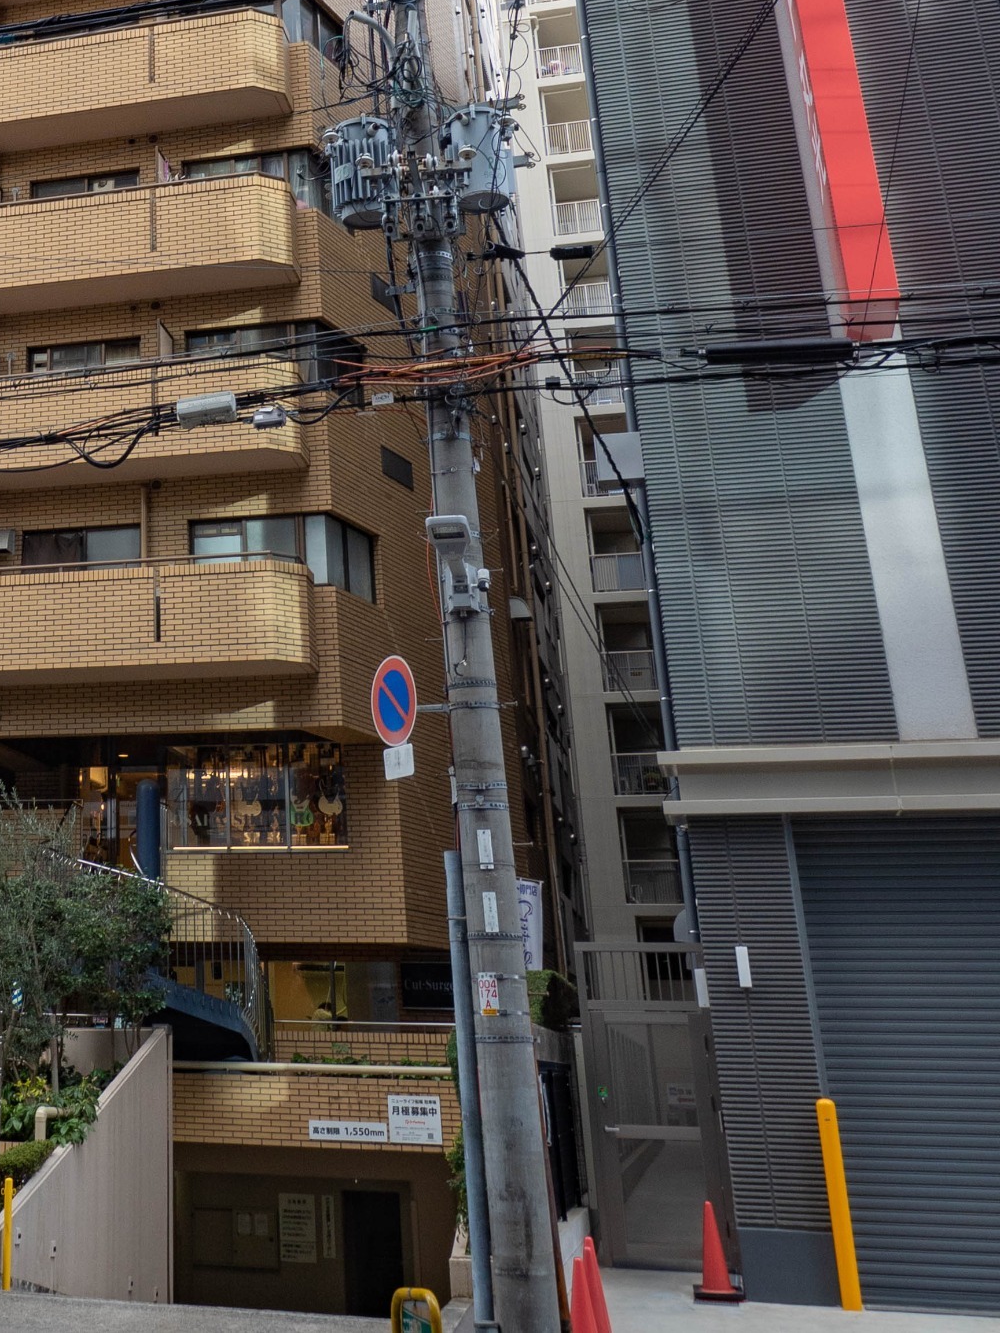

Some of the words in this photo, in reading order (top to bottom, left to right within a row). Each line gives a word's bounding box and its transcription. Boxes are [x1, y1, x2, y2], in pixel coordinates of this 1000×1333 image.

[479, 979, 497, 989] 004
[485, 999, 492, 1009] A
[391, 1106, 437, 1117] 月極募集中
[312, 1126, 340, 1135] 高さ制限
[344, 1127, 385, 1136] 1,550mm
